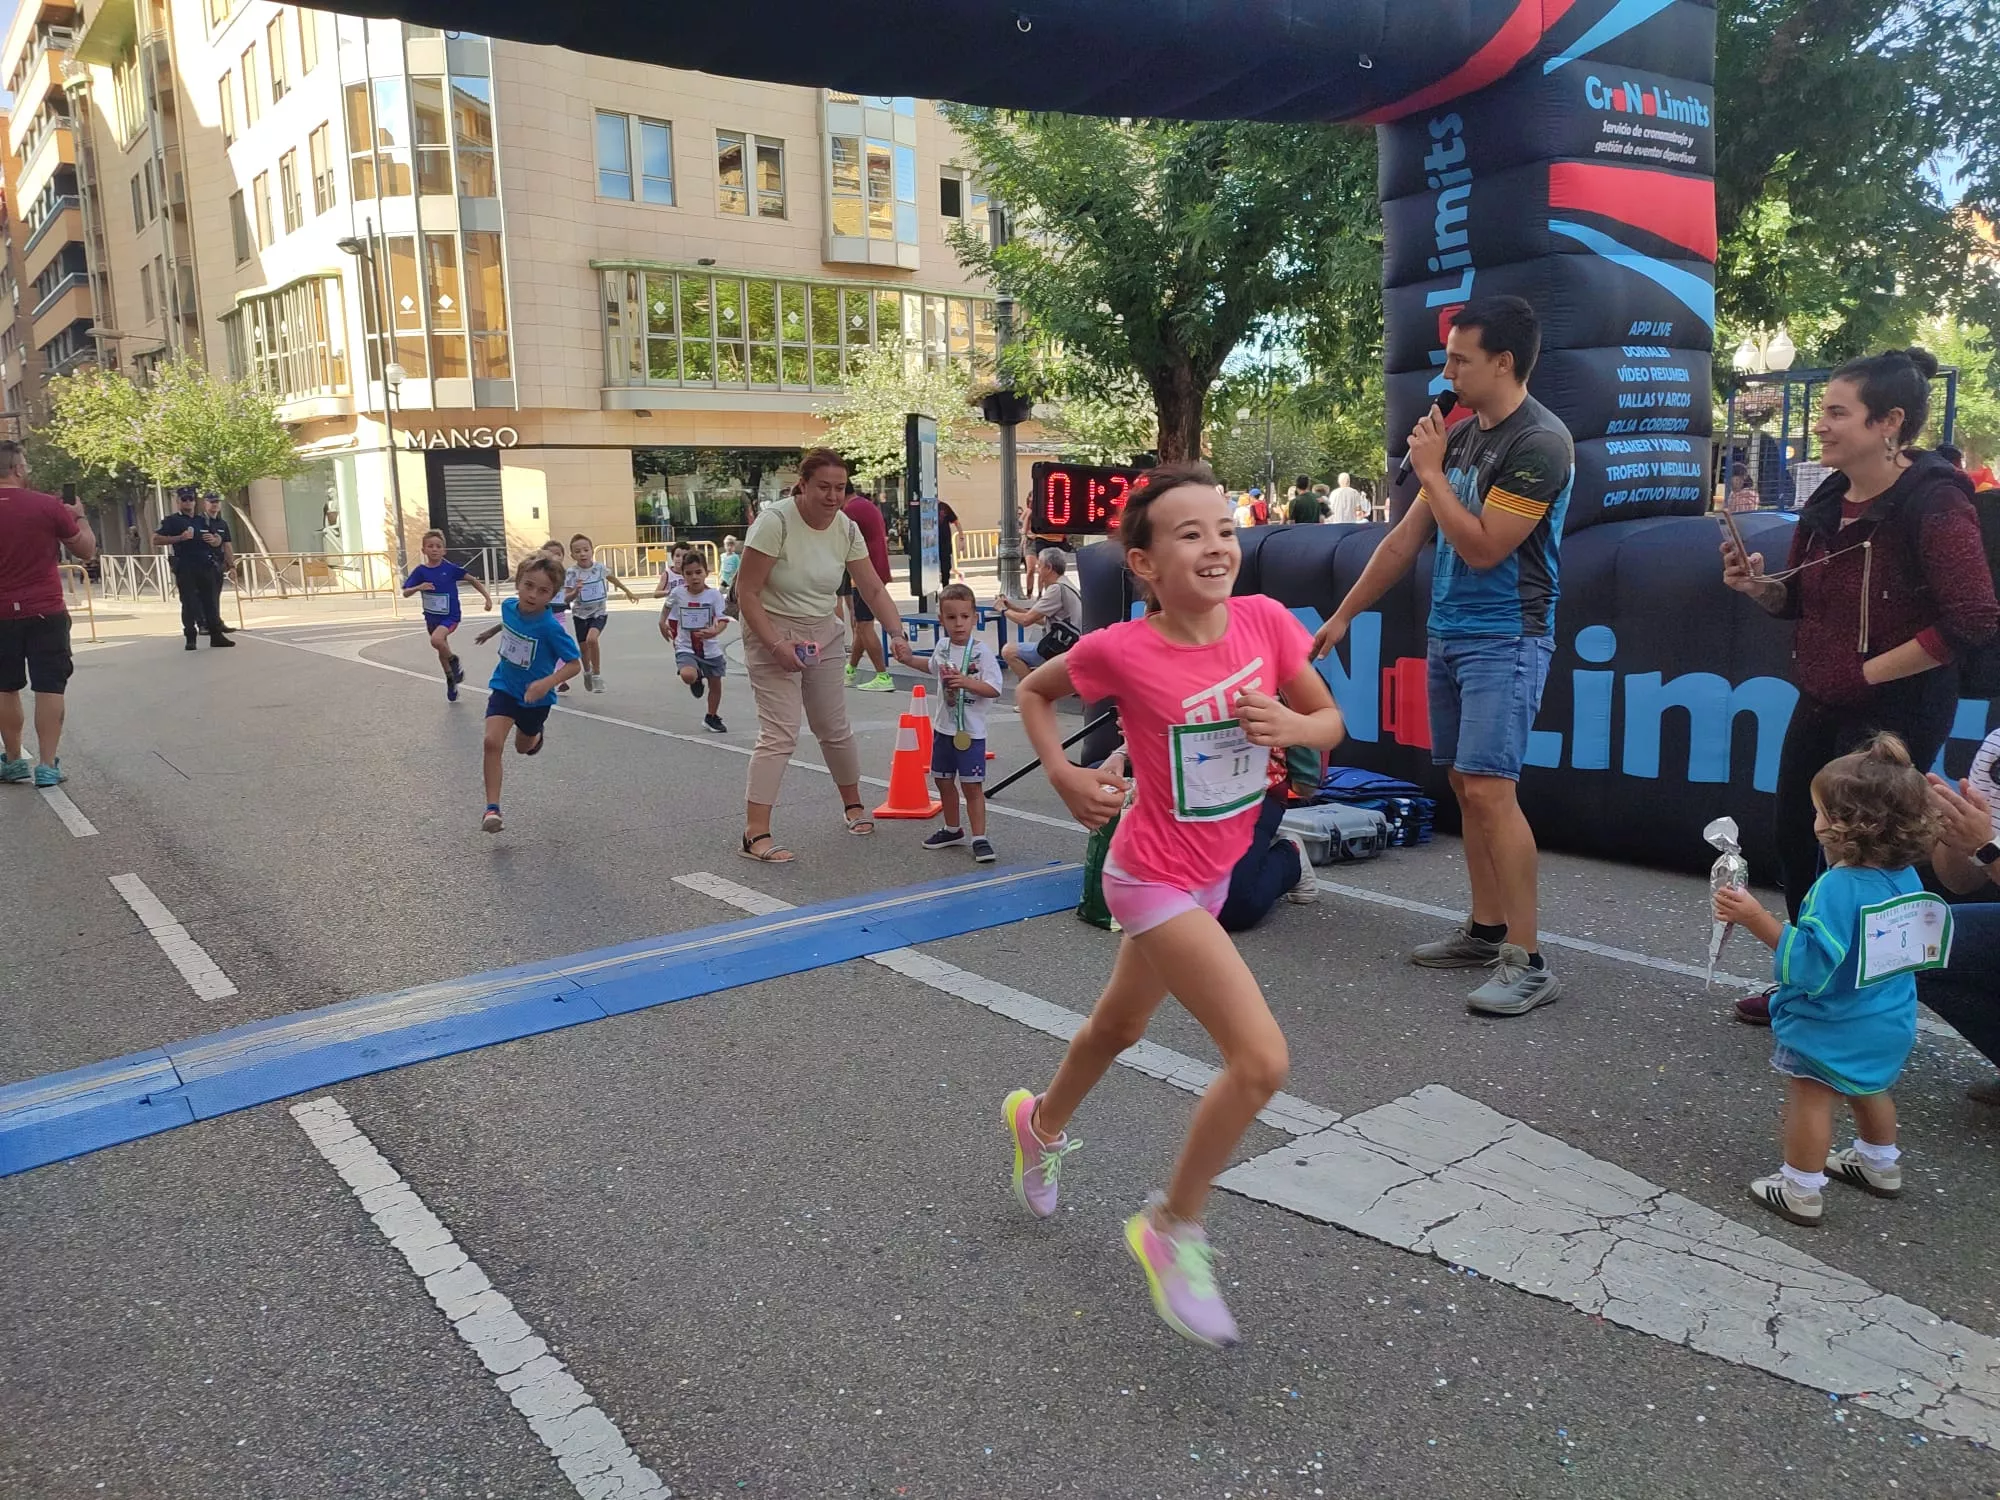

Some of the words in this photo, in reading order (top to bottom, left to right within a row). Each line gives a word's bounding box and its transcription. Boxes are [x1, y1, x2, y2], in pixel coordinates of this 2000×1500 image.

[1602, 119, 1631, 136] Servicio
[1632, 124, 1643, 137] de
[1594, 140, 1622, 153] gestión
[1623, 142, 1634, 155] de
[1633, 146, 1663, 158] eventos
[1662, 147, 1697, 164] deportivos
[1628, 321, 1653, 336] APP
[1651, 322, 1674, 337] LIVE
[1617, 364, 1649, 382] VÍDEO
[1649, 366, 1690, 382] RESUMEN
[1618, 392, 1656, 408] VALLAS
[1656, 392, 1666, 407] Y
[1664, 392, 1692, 407] ARCOS
[1605, 419, 1638, 434] BOLSA
[1638, 417, 1690, 432] CORREDOR
[404, 426, 518, 449] MANGO
[1605, 440, 1652, 455] SPEAKER
[1659, 438, 1692, 453] SONIDO
[1606, 463, 1650, 481] TROFEOS
[1650, 463, 1659, 477] Y
[1659, 462, 1702, 477] MEDALLAS
[1603, 490, 1629, 507] CHIP
[1627, 487, 1665, 502] ACTIVO
[1231, 754, 1251, 777] 11
[1901, 930, 1908, 949] 8
